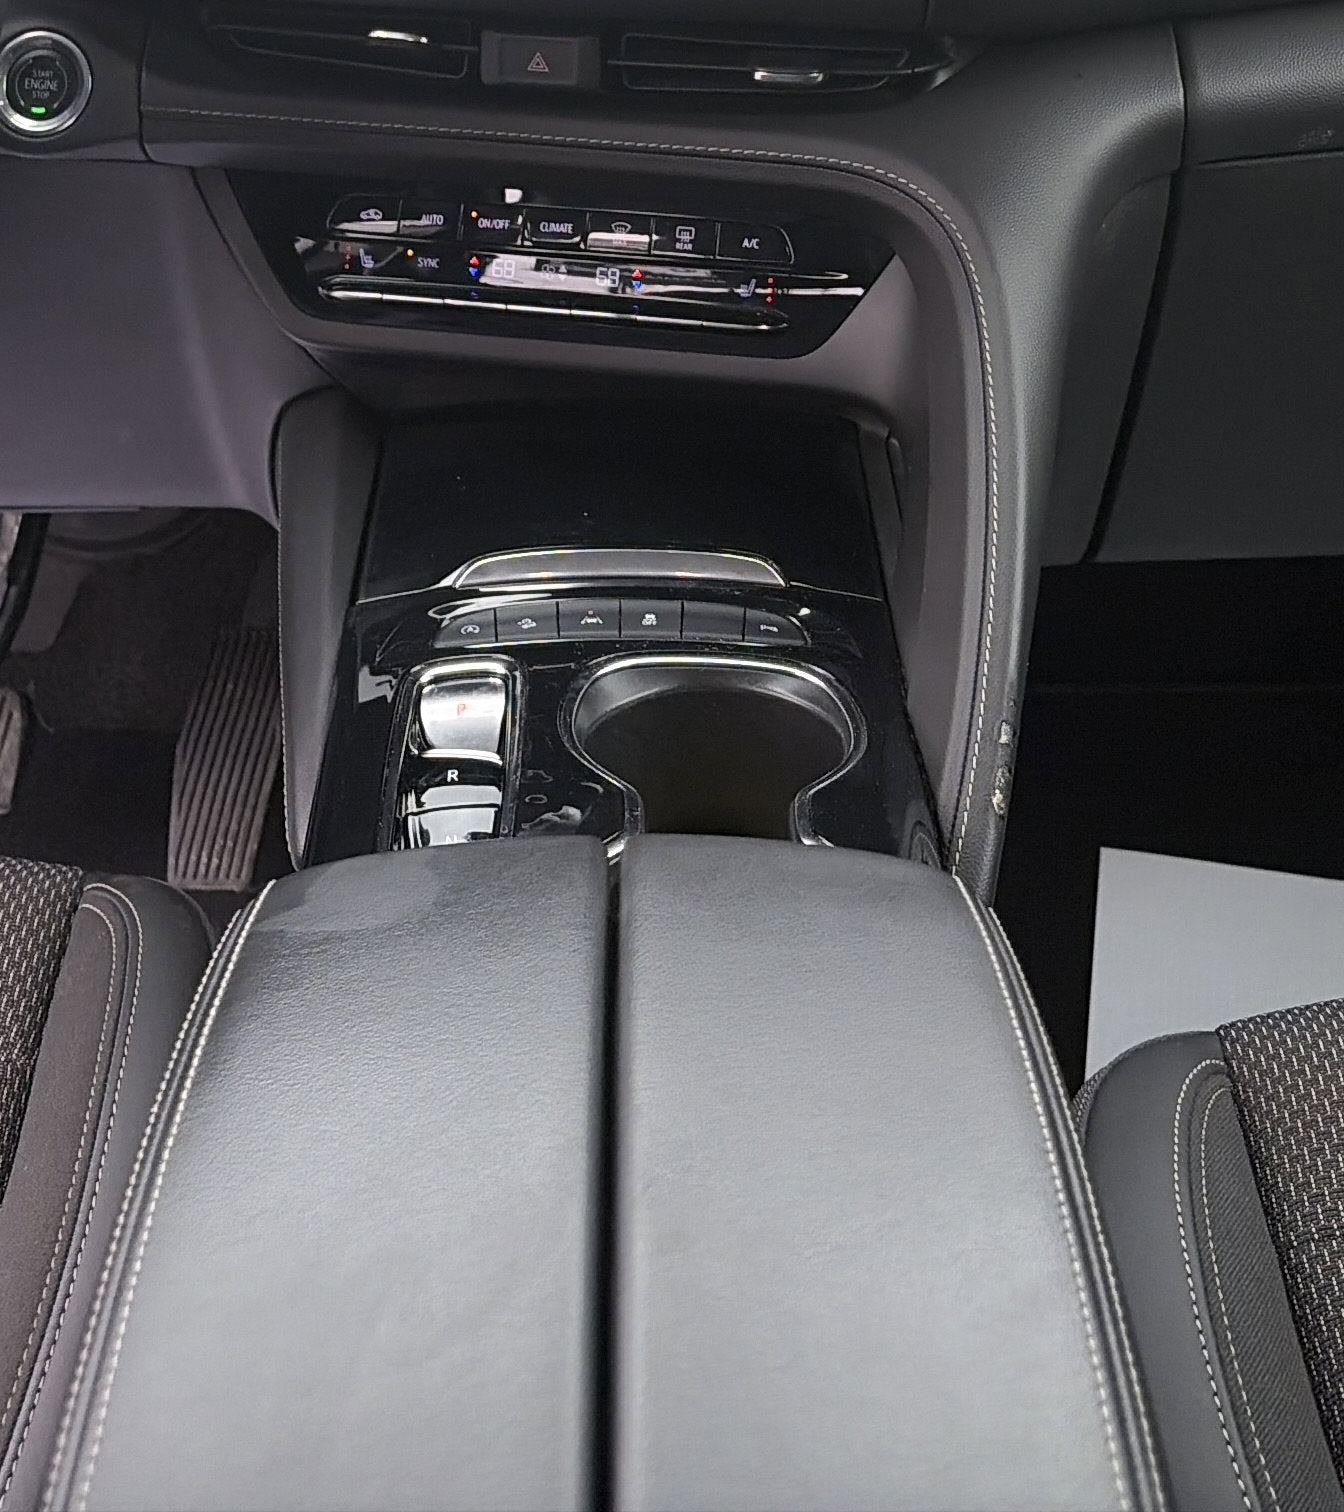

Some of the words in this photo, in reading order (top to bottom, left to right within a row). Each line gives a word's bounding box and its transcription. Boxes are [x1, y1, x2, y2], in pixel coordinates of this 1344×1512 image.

[32, 70, 54, 78] START
[25, 78, 59, 91] ENGINE
[32, 91, 50, 99] STOP
[421, 214, 444, 225] AUTO
[478, 218, 511, 230] ON/OFF
[539, 222, 574, 234] CLIMATE
[675, 242, 693, 251] REAR
[742, 237, 760, 249] A/C
[417, 257, 440, 269] SYNC
[447, 769, 459, 783] R
